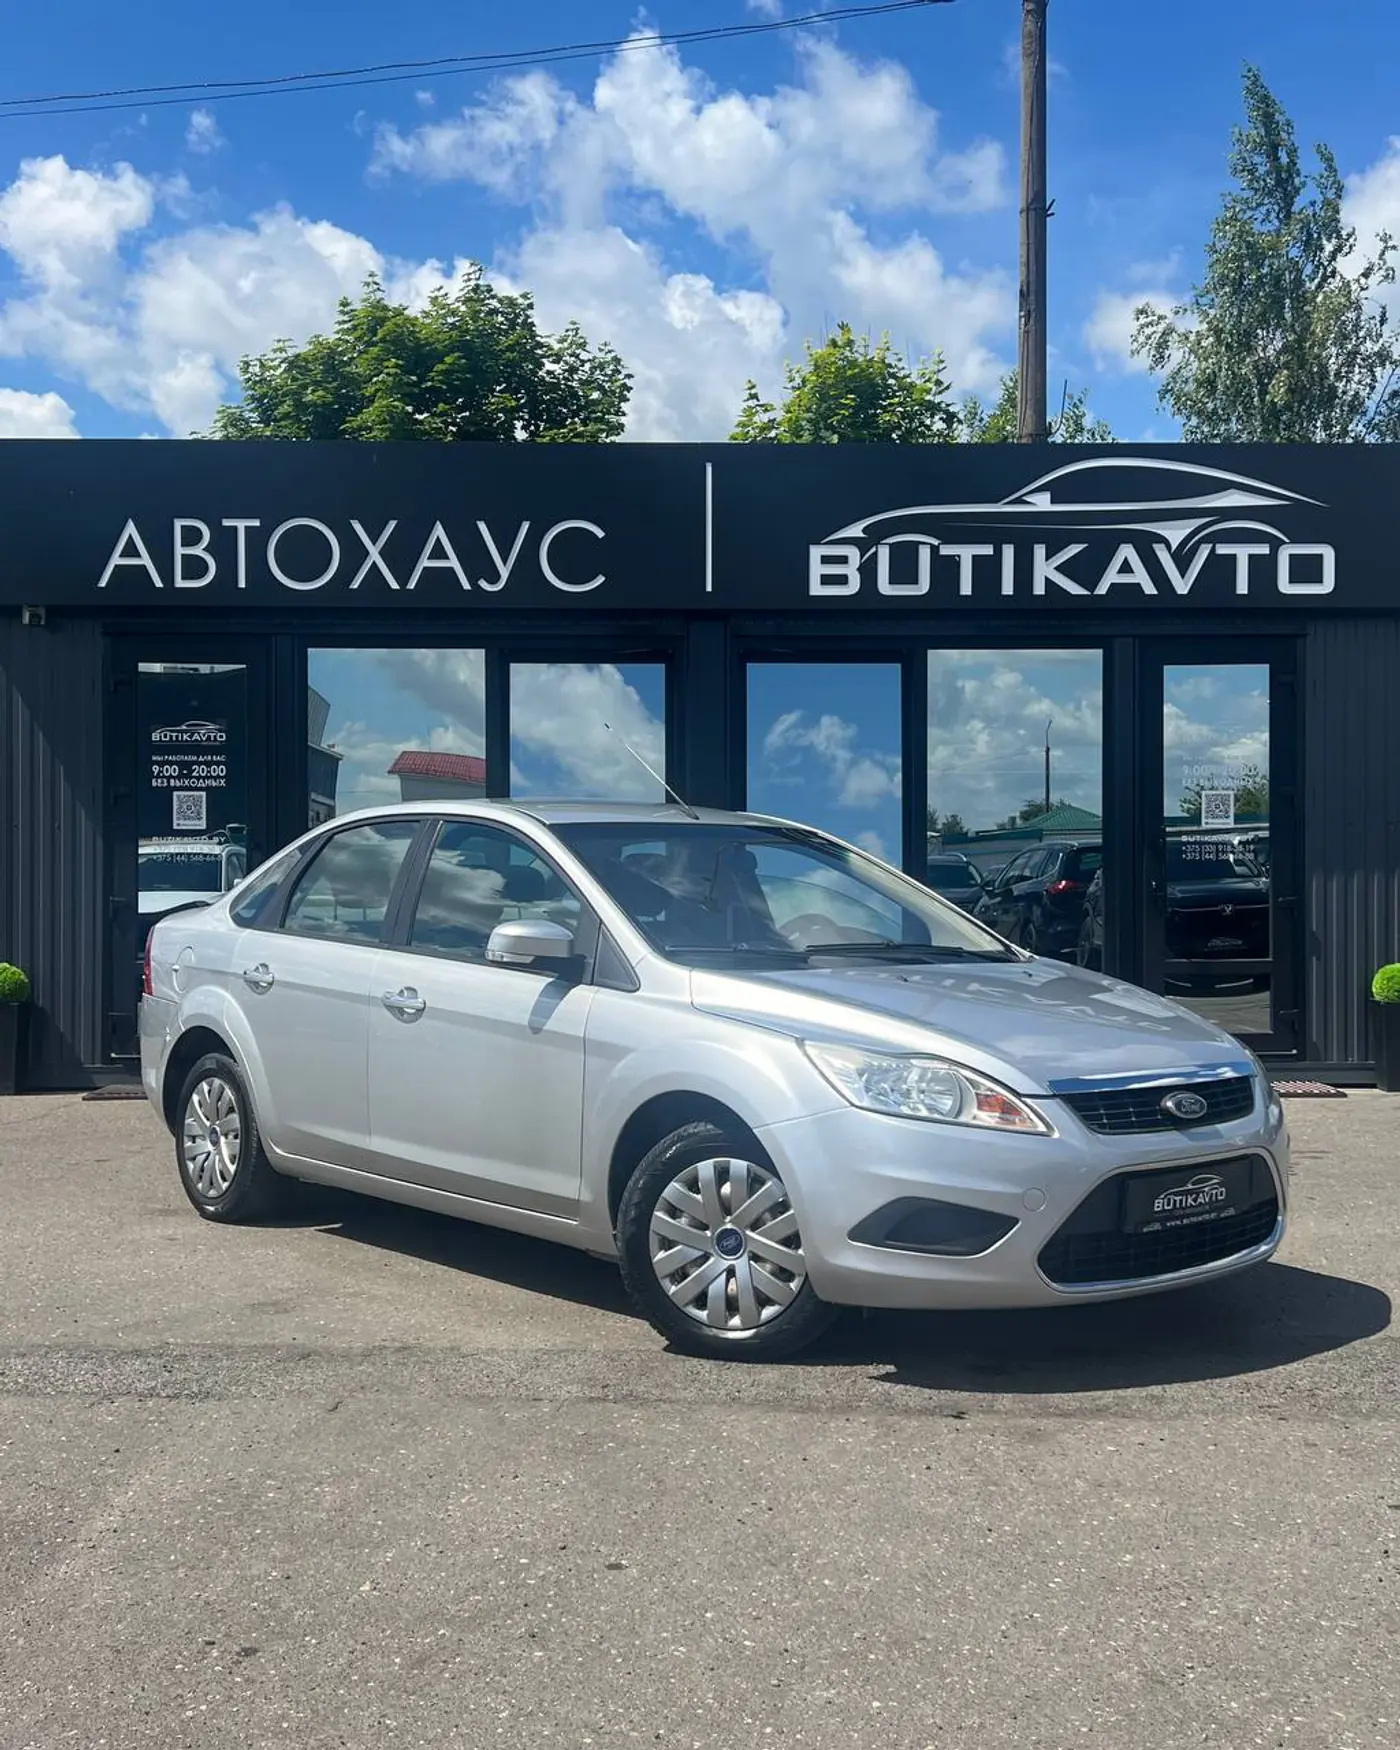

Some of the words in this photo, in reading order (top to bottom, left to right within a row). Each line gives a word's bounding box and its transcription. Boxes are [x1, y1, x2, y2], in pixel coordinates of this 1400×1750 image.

[97, 517, 606, 593] АВТОХАУС
[808, 542, 1337, 596] BUTIKAVTO
[152, 732, 227, 741] BUTIKAVTO
[152, 765, 179, 776] 9:00
[191, 765, 226, 776] 20:00
[152, 778, 168, 787] БЕЗ
[169, 778, 226, 788] ВЫХОДНЫХ
[1153, 1186, 1226, 1213] BUTIKAVTO
